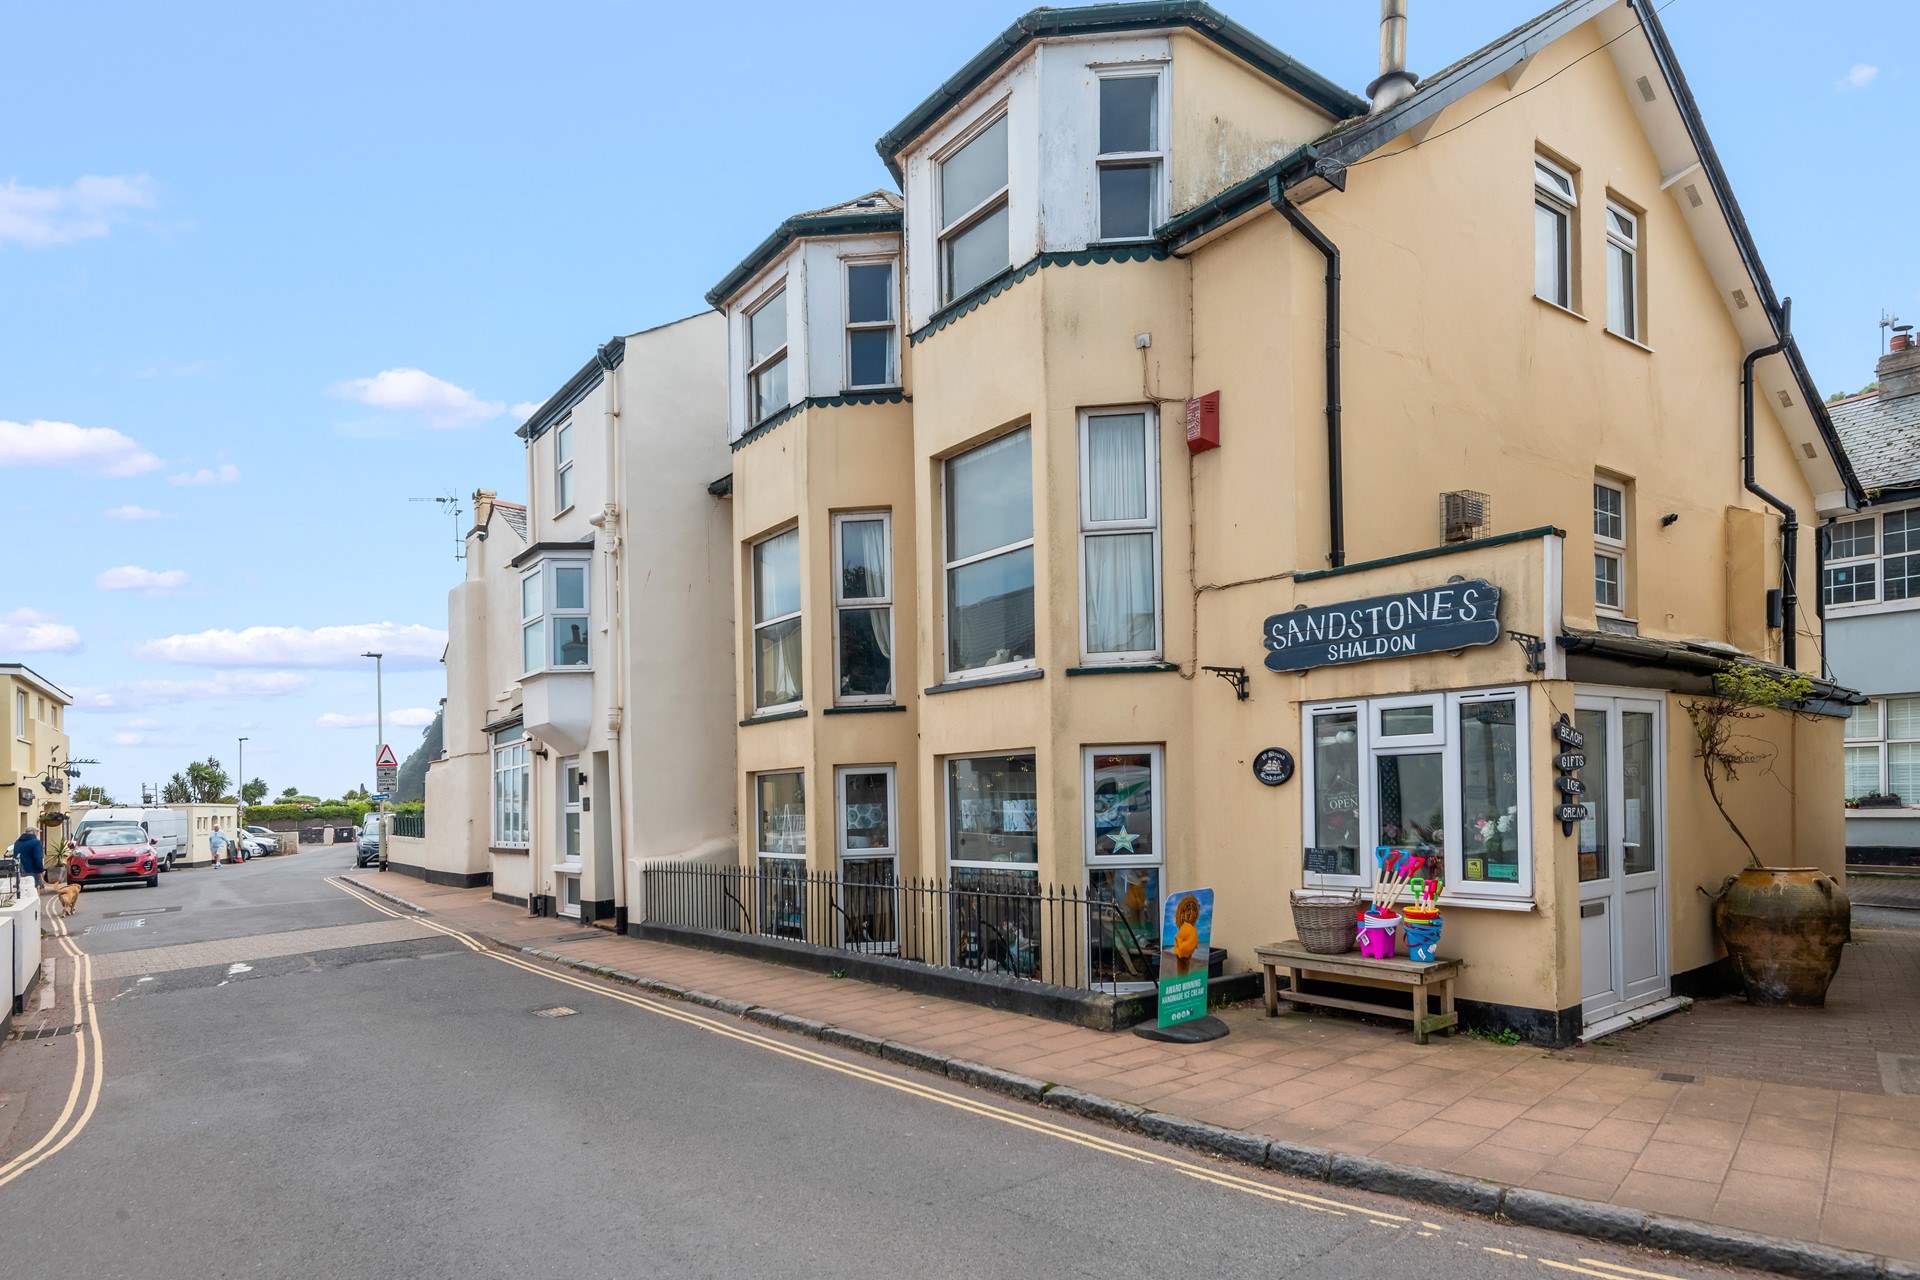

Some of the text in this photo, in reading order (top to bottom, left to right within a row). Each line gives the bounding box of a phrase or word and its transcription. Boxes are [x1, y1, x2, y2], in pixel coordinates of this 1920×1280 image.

[1272, 589, 1479, 650] SANDSTONES
[1327, 634, 1416, 661] SHALDON
[1560, 726, 1583, 745] BEACH
[1562, 755, 1585, 768] GIFTS
[1567, 779, 1580, 792] ICE
[1329, 798, 1359, 810] OPEN
[1562, 807, 1586, 818] CREAM
[1165, 983, 1182, 995] AWARD
[1183, 990, 1191, 999] ICE
[1190, 987, 1204, 998] CREAM
